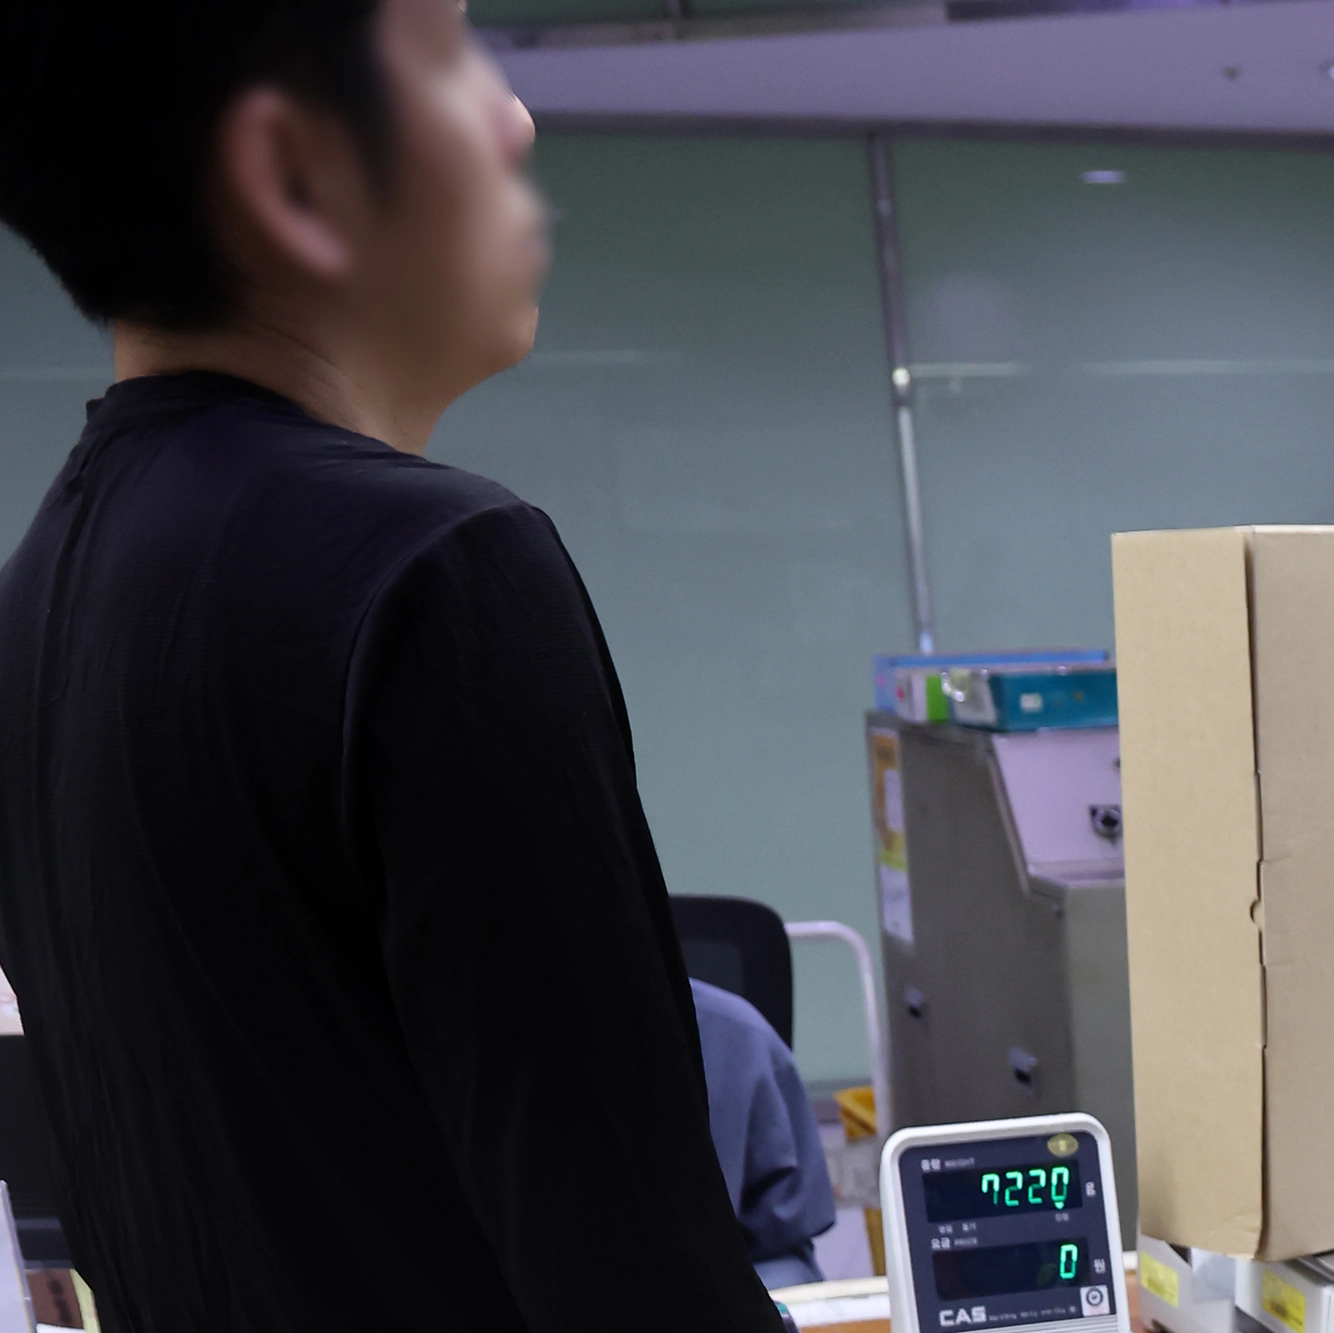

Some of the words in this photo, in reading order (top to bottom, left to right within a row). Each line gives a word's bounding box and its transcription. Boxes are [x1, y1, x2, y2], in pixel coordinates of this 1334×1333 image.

[981, 1166, 1069, 1206] 7220
[1060, 1244, 1078, 1279] 0
[939, 1307, 987, 1327] CAS
